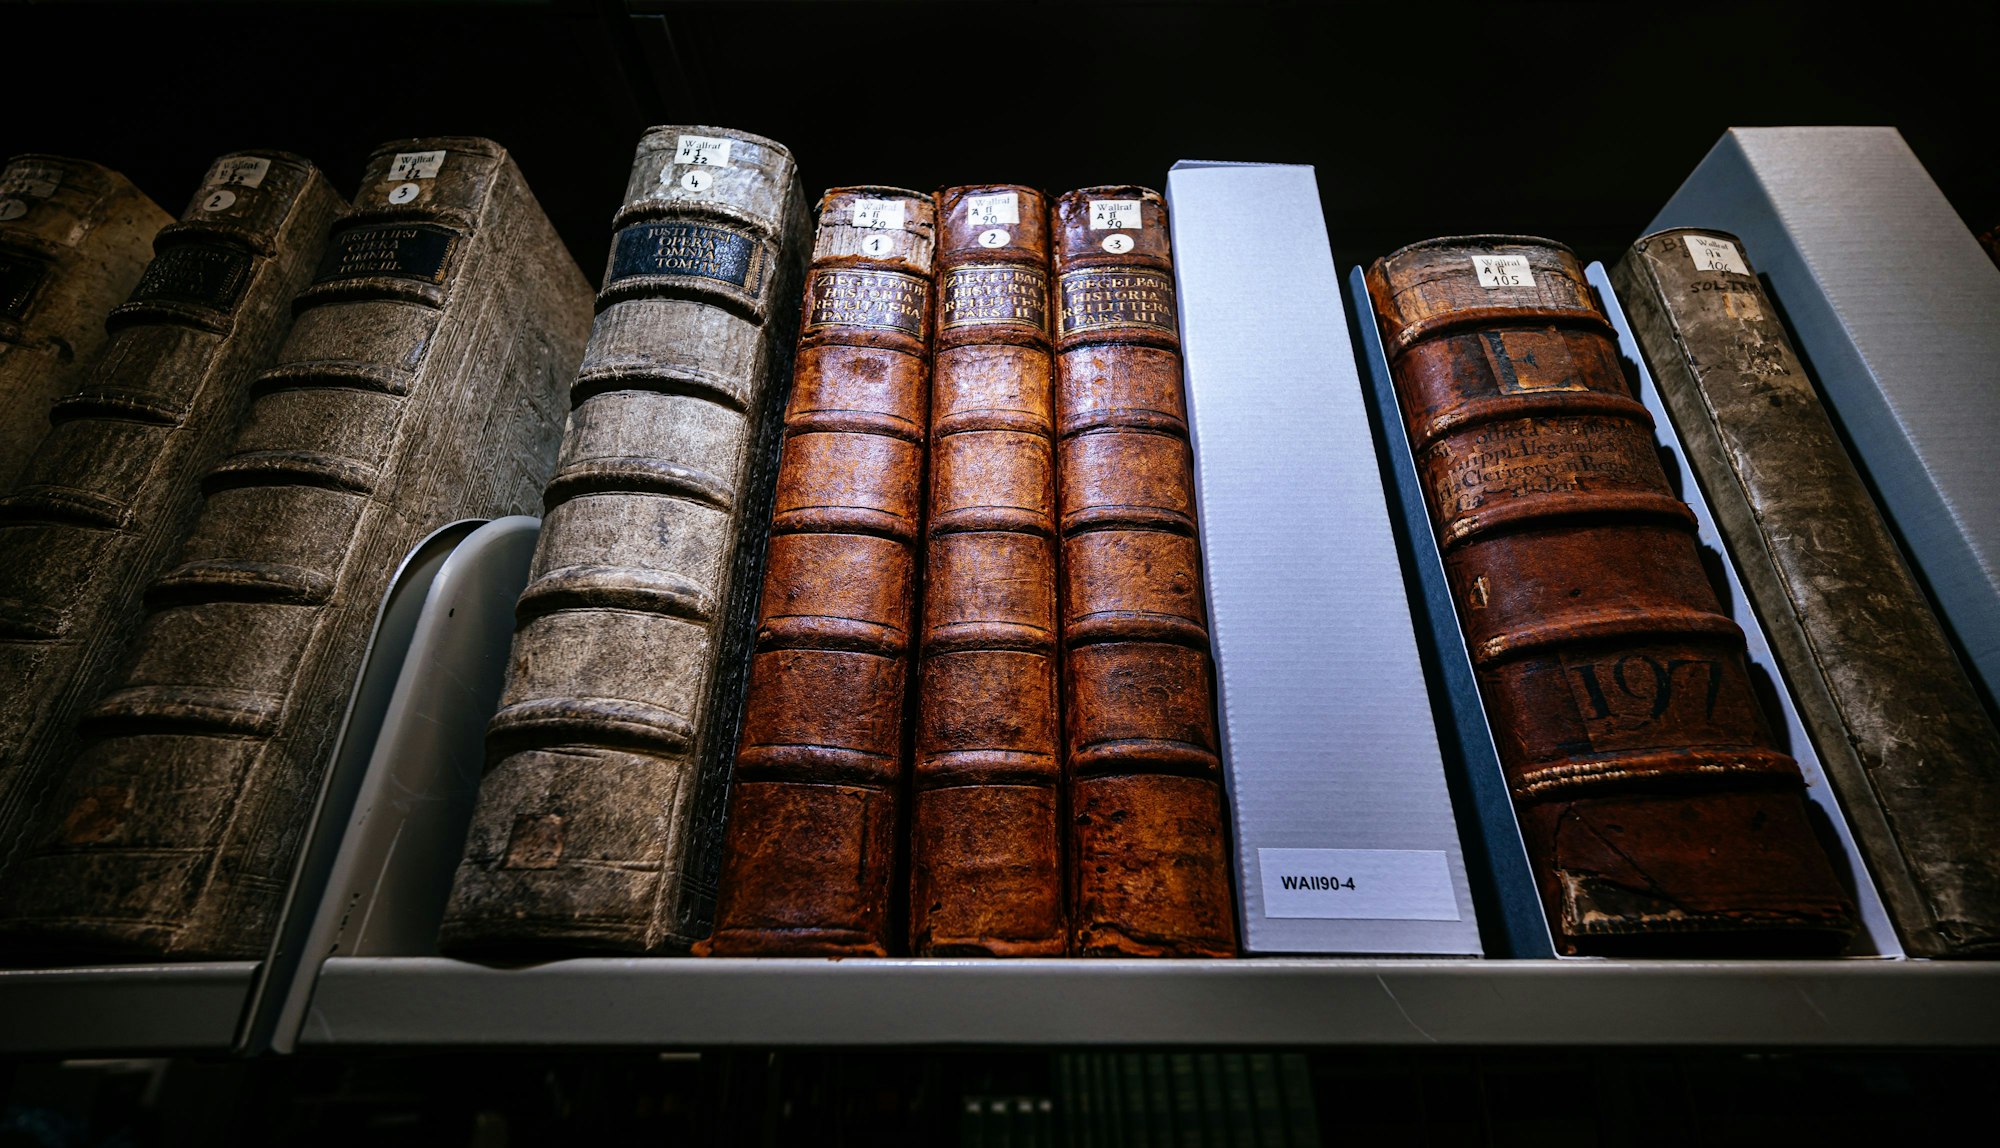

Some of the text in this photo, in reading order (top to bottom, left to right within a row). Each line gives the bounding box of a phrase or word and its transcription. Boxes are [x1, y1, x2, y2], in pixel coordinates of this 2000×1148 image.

[685, 140, 721, 150] Wallraf
[683, 148, 690, 156] H
[401, 155, 434, 165] Wallraf
[691, 175, 699, 187] 4
[398, 187, 408, 199] 3
[210, 195, 221, 207] 2
[975, 197, 1010, 207] Wallraf
[862, 203, 898, 211] Wallraf
[971, 208, 979, 216] A
[1096, 204, 1132, 212] Wallraf
[982, 215, 998, 225] 90
[1107, 219, 1122, 229] 90
[659, 236, 715, 250] OPERA
[988, 233, 997, 245] 2
[870, 239, 879, 251] 1
[657, 246, 715, 260] OMNIA
[1482, 259, 1520, 267] Wallraf
[1493, 275, 1519, 285] 105
[825, 288, 913, 304] HISTORIA
[954, 284, 1038, 298] HISTORIA
[1072, 290, 1159, 305] HISTORIA
[822, 312, 868, 322] PARS
[955, 309, 1000, 319] PARS
[1075, 312, 1122, 326] PARS
[1570, 655, 1722, 731] 197
